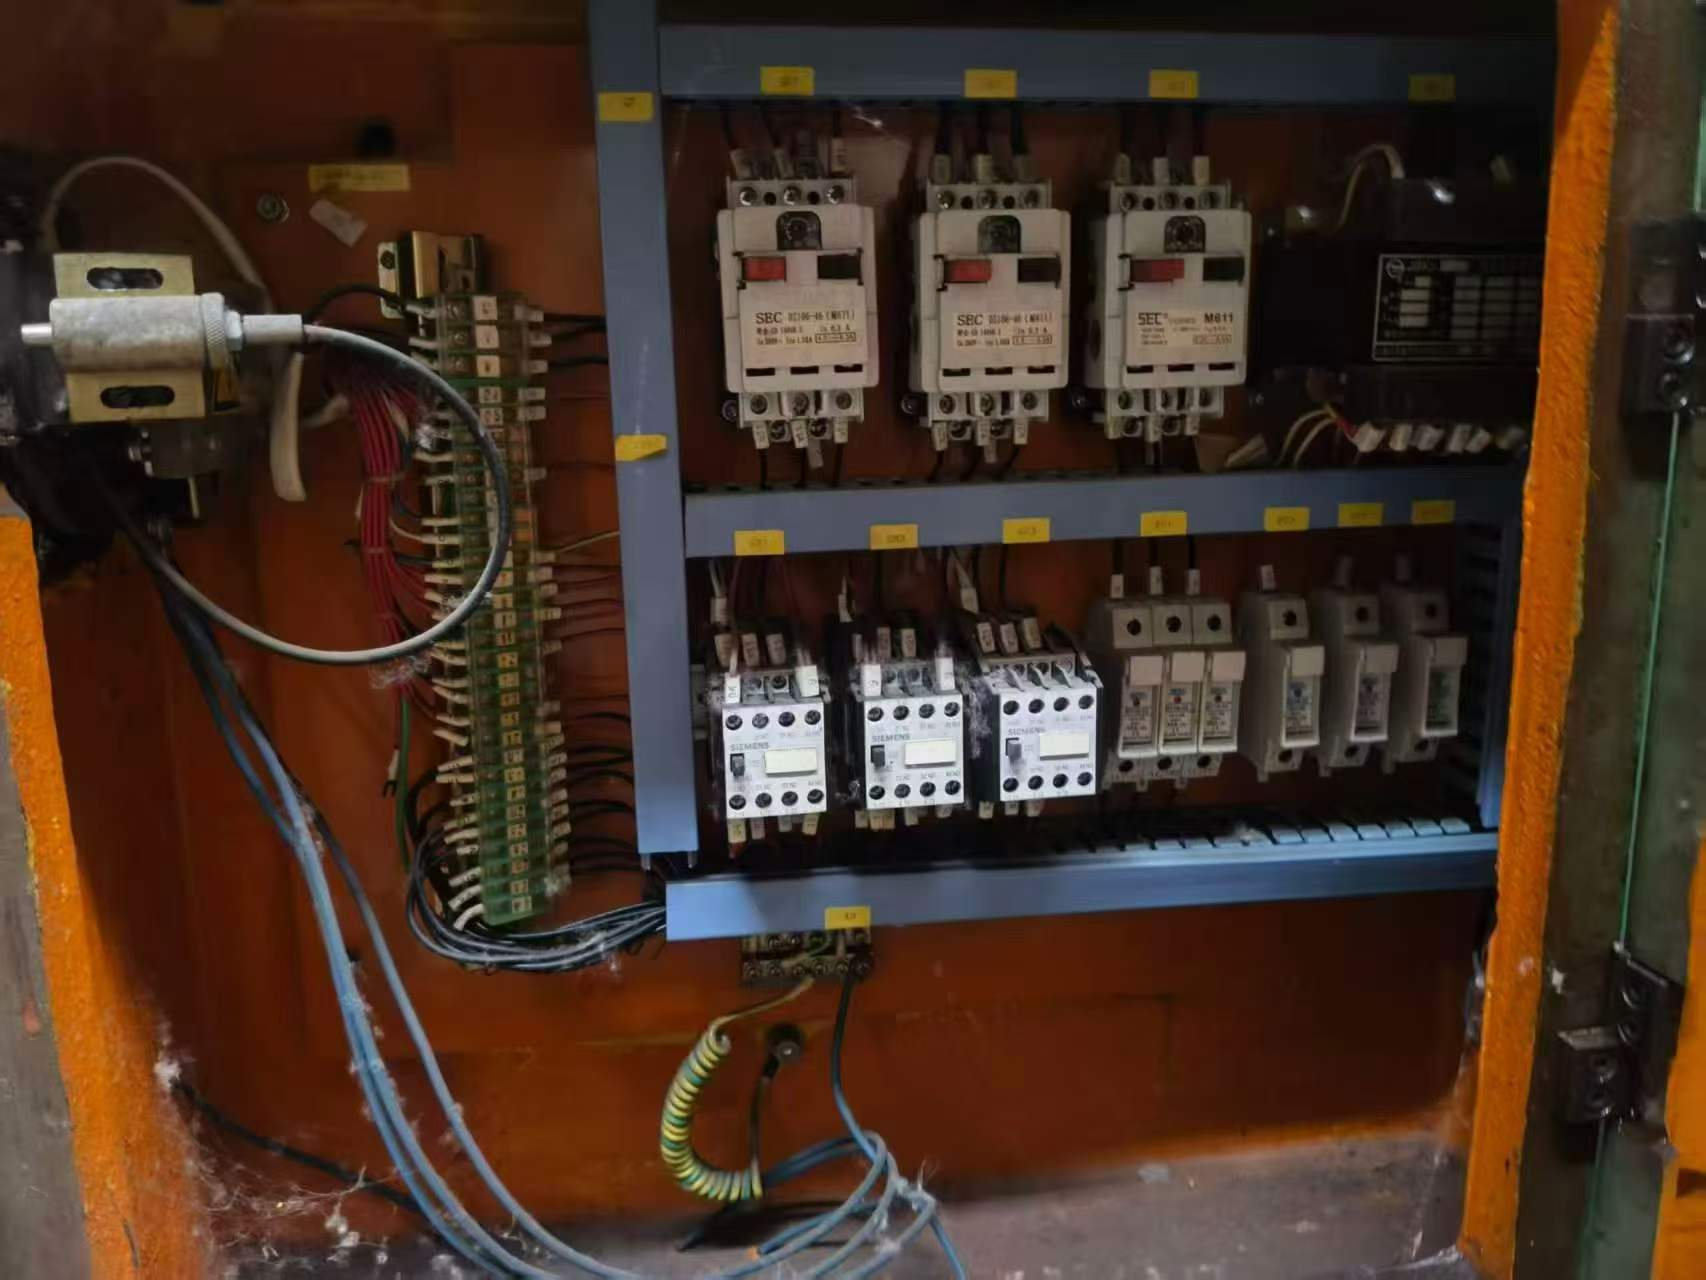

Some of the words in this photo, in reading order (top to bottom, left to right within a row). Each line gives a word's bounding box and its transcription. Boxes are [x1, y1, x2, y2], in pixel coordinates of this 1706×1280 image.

[755, 312, 783, 324] SEC
[957, 314, 984, 326] SEC
[1138, 312, 1163, 325] SEC
[1204, 312, 1233, 323] M611
[1007, 727, 1046, 736] SIEMENS
[872, 733, 910, 743] SIEMENS
[730, 741, 770, 751] SIEMENS
